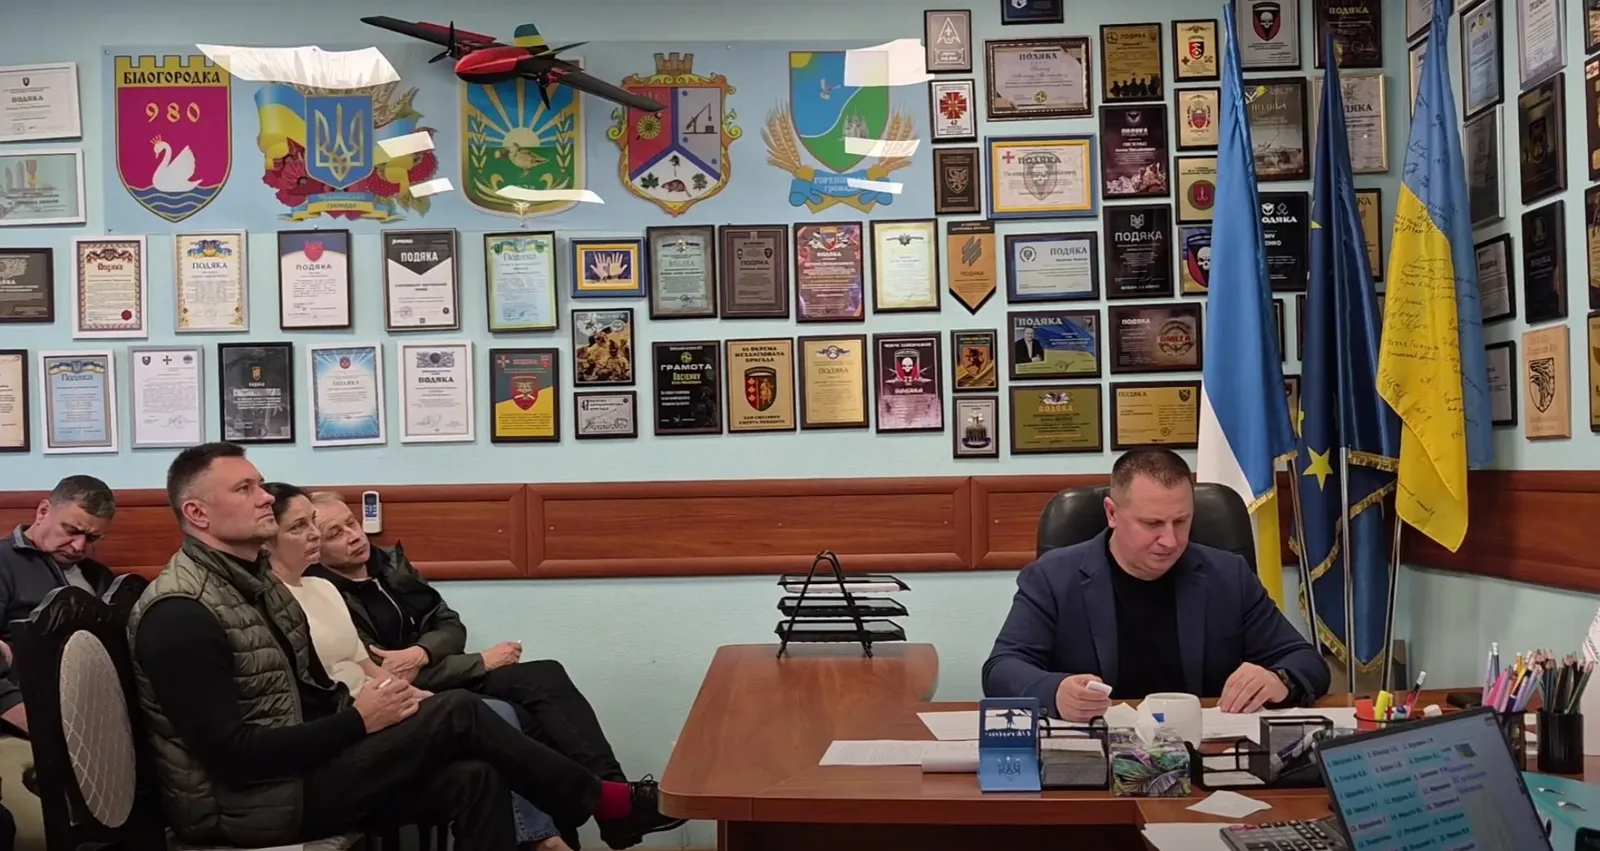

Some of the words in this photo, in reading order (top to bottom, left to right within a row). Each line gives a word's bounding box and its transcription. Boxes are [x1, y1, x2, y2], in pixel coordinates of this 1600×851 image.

[124, 71, 221, 84] БІЛОГОРОДКА
[1018, 156, 1061, 164] ПОДЯКА
[1115, 231, 1163, 242] ПОДЯКА
[401, 251, 439, 262] ПОДЯКА
[1050, 246, 1088, 257] ПОДЯКА
[192, 262, 228, 270] ПОДЯКА
[1018, 317, 1063, 326] ПОДЯКА
